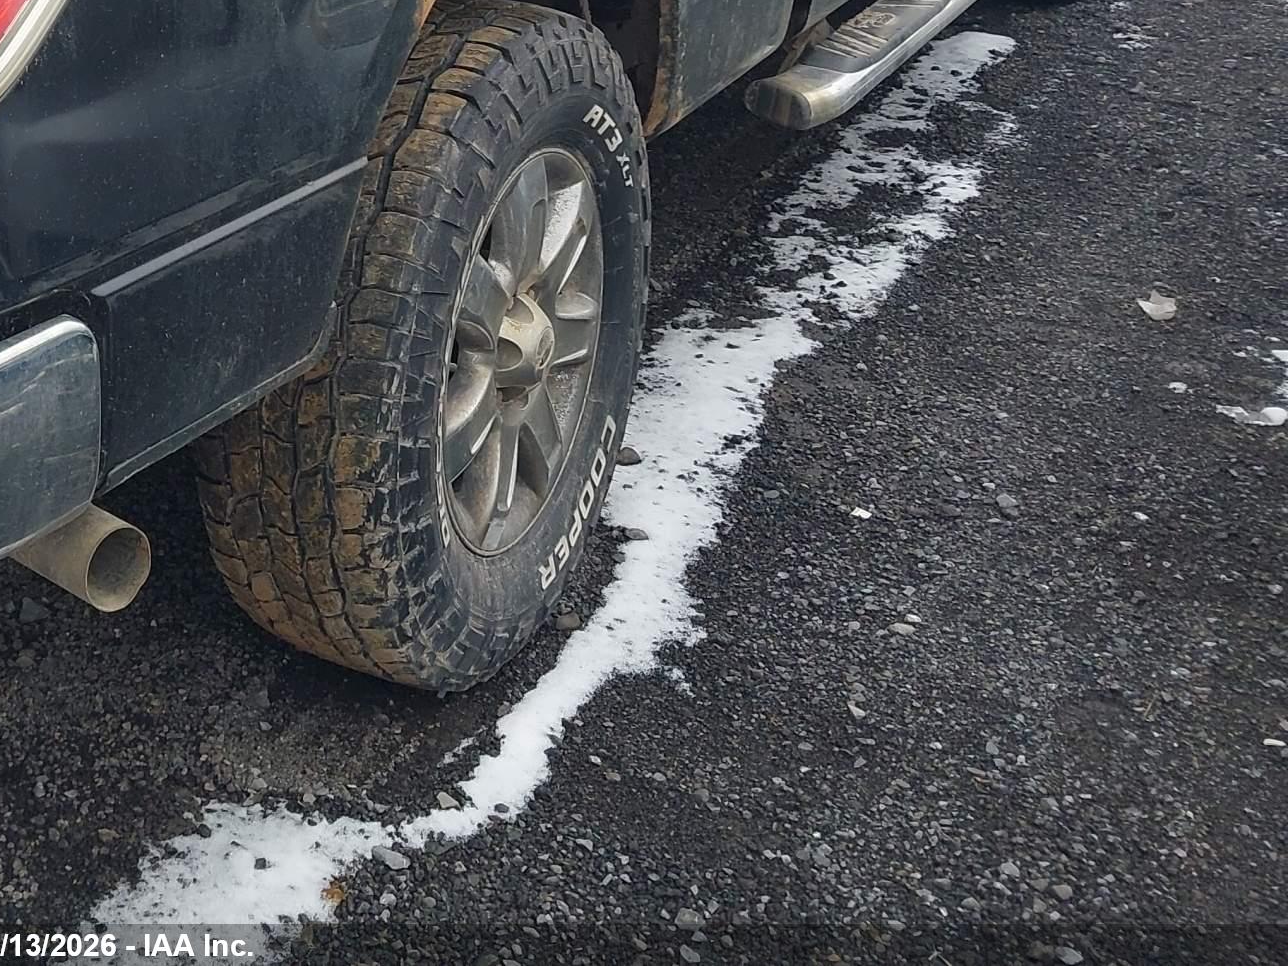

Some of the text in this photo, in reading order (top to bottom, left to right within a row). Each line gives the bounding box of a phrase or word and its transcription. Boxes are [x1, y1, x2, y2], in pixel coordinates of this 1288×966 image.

[582, 103, 634, 187] AT3 XLT
[538, 415, 616, 590] COOPER
